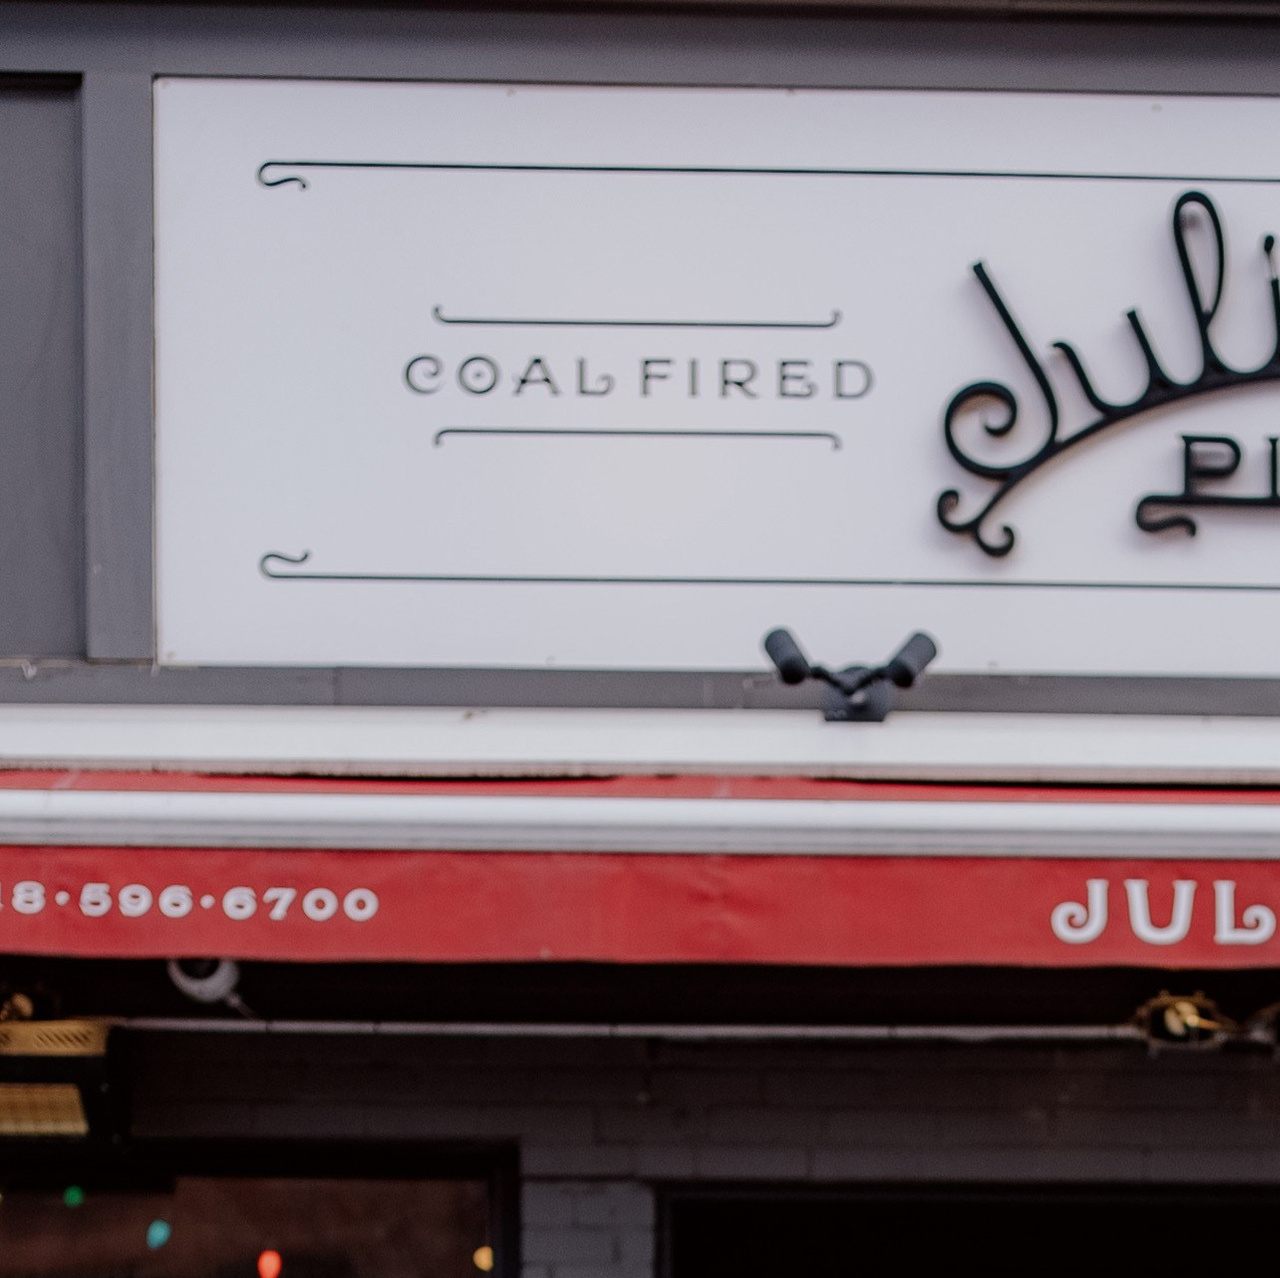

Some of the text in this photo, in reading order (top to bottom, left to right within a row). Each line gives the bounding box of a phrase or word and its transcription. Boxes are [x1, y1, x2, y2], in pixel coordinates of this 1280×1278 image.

[403, 354, 876, 400] COAL FIRED
[0, 880, 380, 922] 8·596·6700
